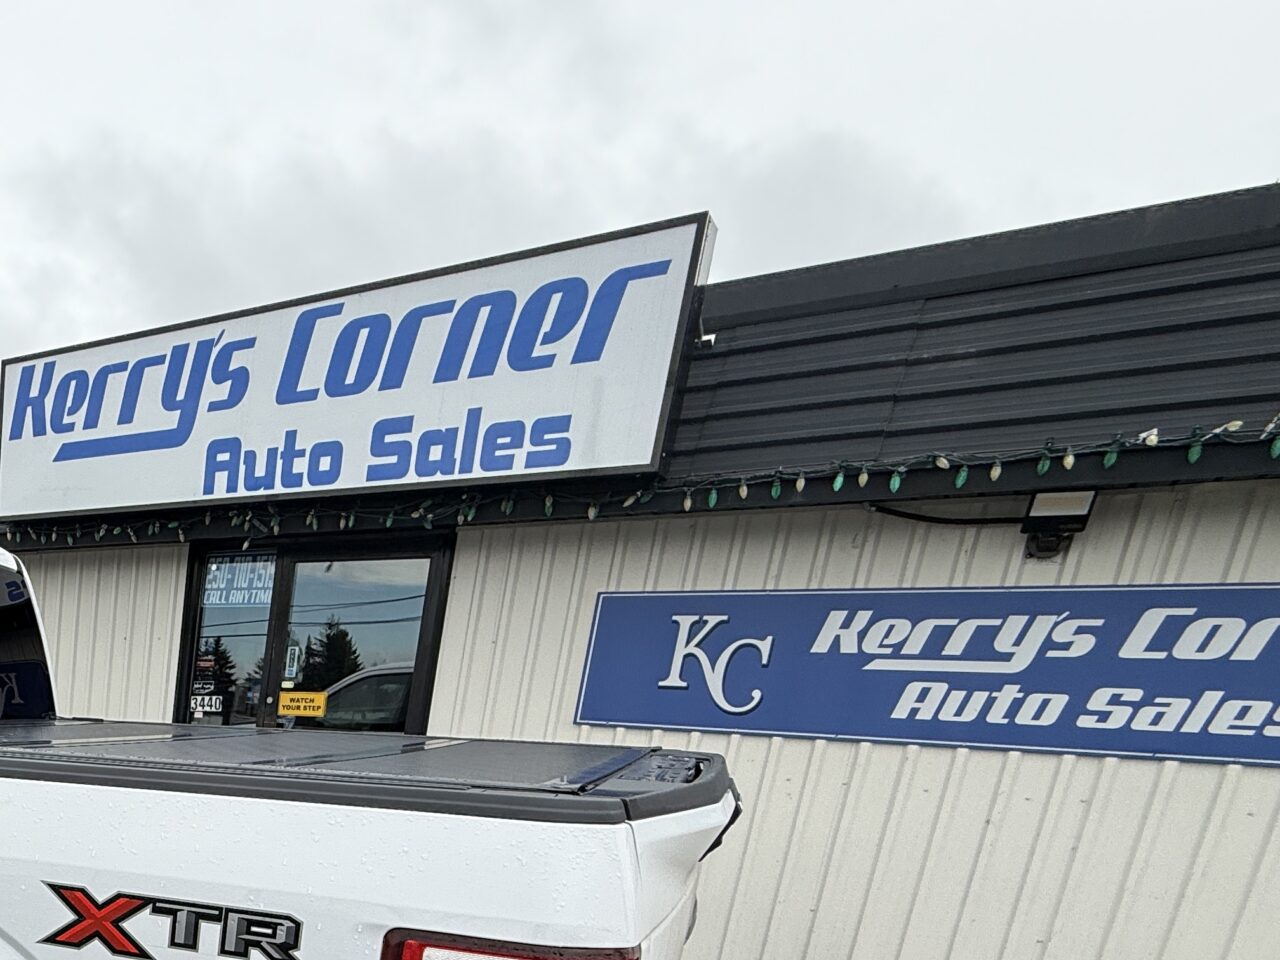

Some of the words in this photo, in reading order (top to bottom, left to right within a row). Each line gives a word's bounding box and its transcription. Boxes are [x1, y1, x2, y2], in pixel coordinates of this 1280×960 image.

[8, 328, 257, 462] Kerry's
[275, 259, 673, 406] Corner
[202, 428, 344, 496] Auto
[365, 406, 572, 482] Sales
[657, 614, 774, 714] KC
[810, 610, 1106, 673] Kerry's
[1118, 607, 1280, 661] Cor
[191, 697, 222, 711] 3440
[890, 681, 1071, 726] Auto
